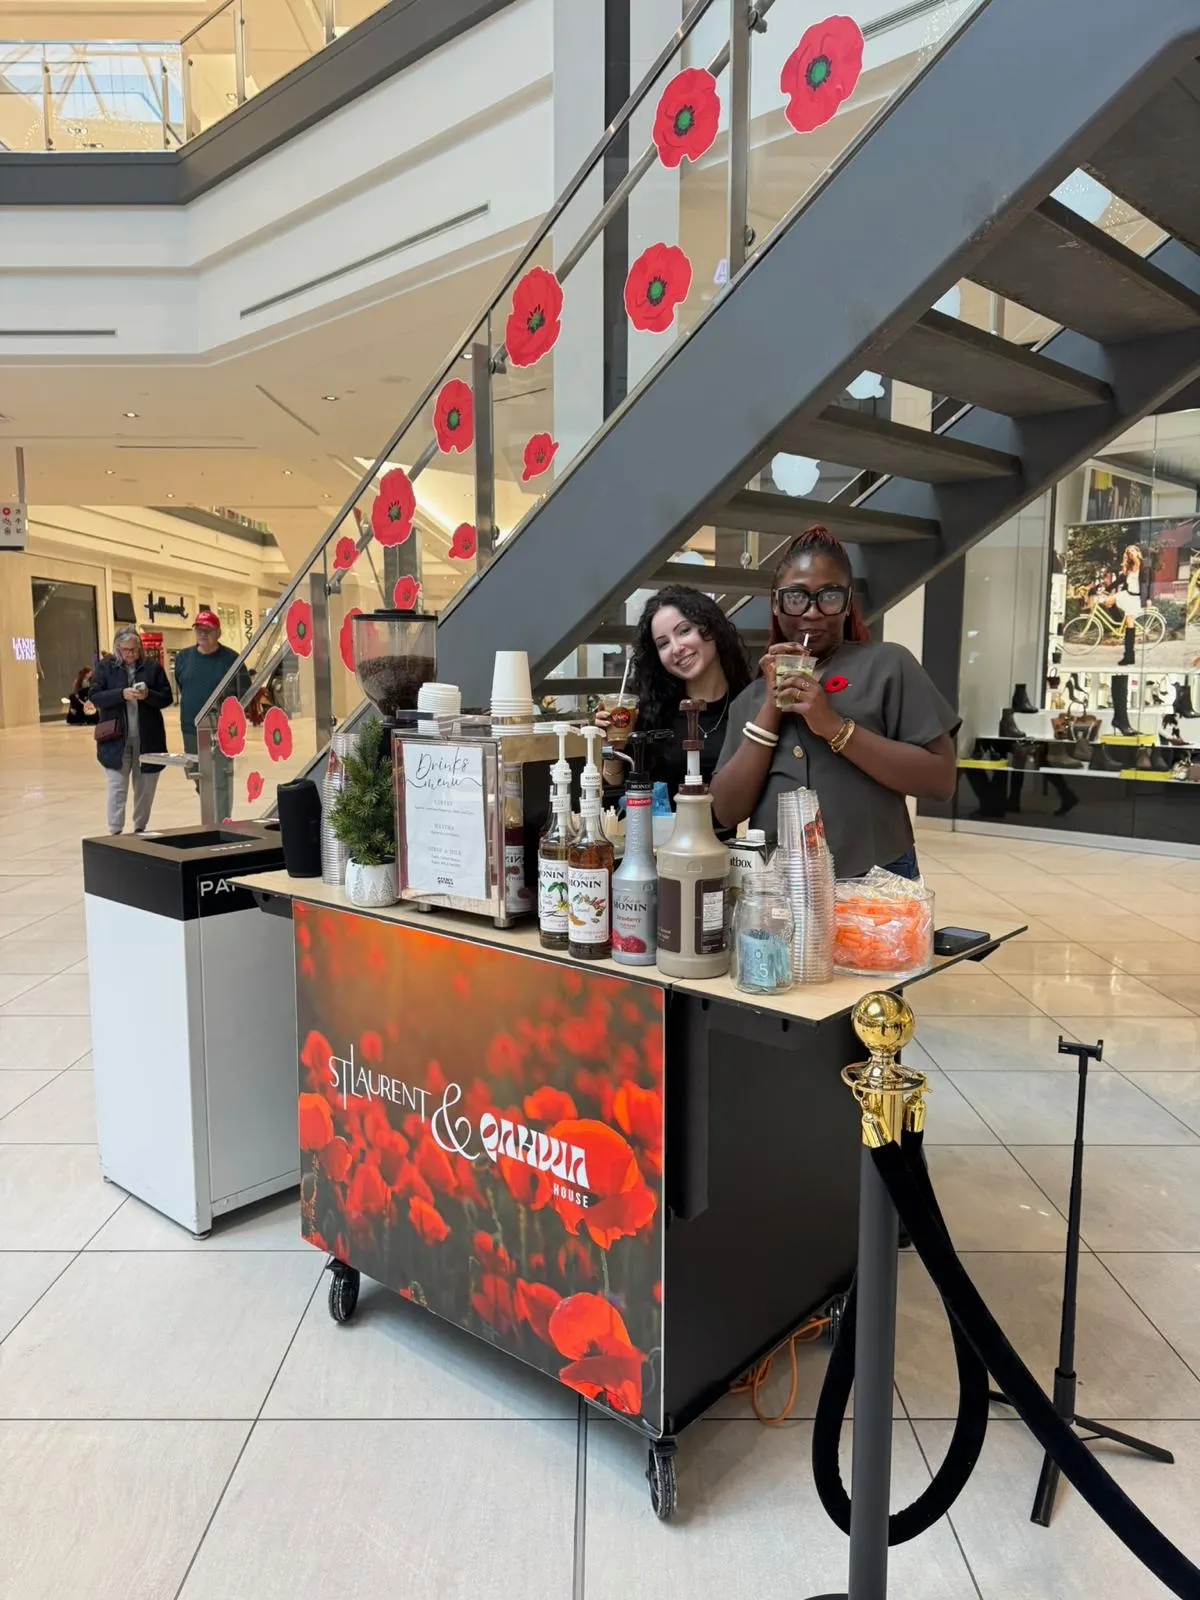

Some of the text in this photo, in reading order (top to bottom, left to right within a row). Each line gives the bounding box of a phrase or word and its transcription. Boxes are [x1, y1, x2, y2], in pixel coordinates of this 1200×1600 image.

[144, 591, 189, 623] Hallmark
[415, 746, 470, 780] Drinks
[200, 878, 236, 897] PA
[431, 1082, 481, 1161] &
[479, 1112, 590, 1190] QAHWA
[553, 1182, 589, 1209] HOUSE
